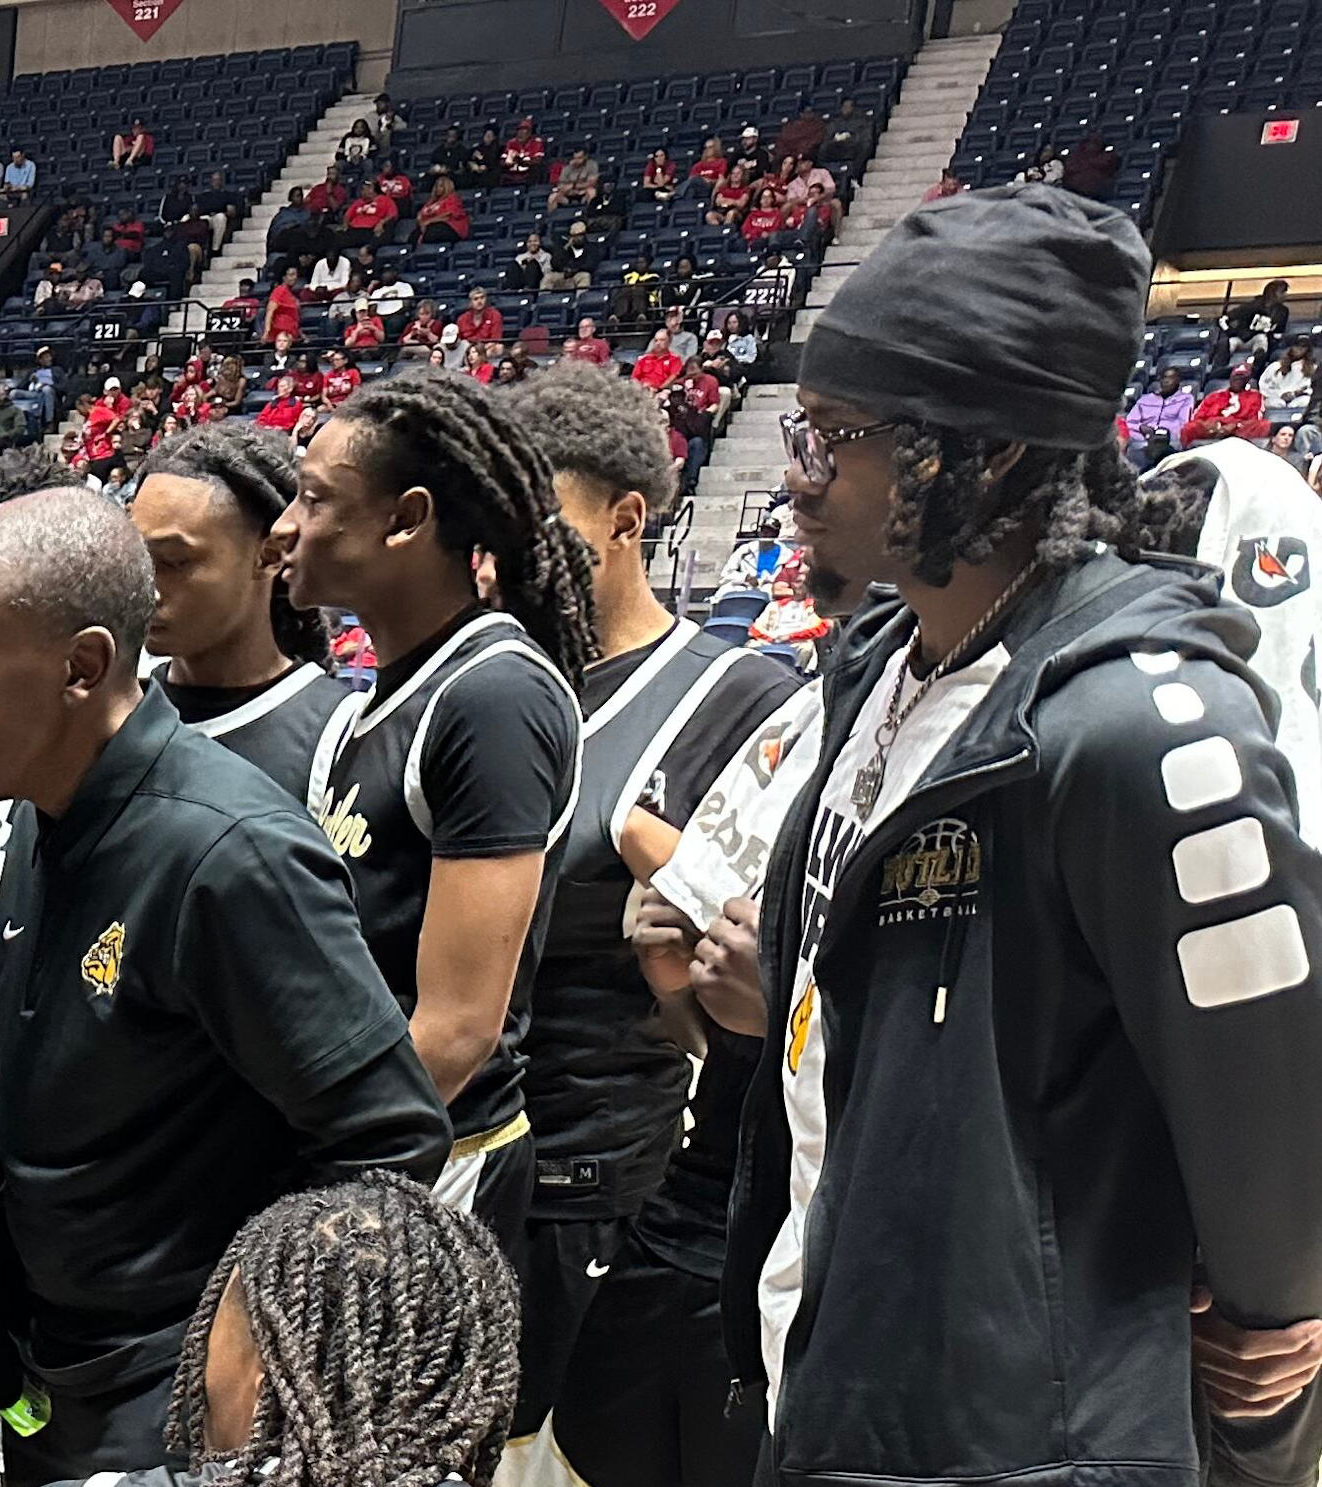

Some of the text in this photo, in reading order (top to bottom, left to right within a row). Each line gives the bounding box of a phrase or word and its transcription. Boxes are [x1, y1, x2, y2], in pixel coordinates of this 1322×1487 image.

[134, 6, 159, 21] 221
[628, 2, 657, 19] 222
[94, 323, 120, 339] 221
[579, 1167, 592, 1179] M
